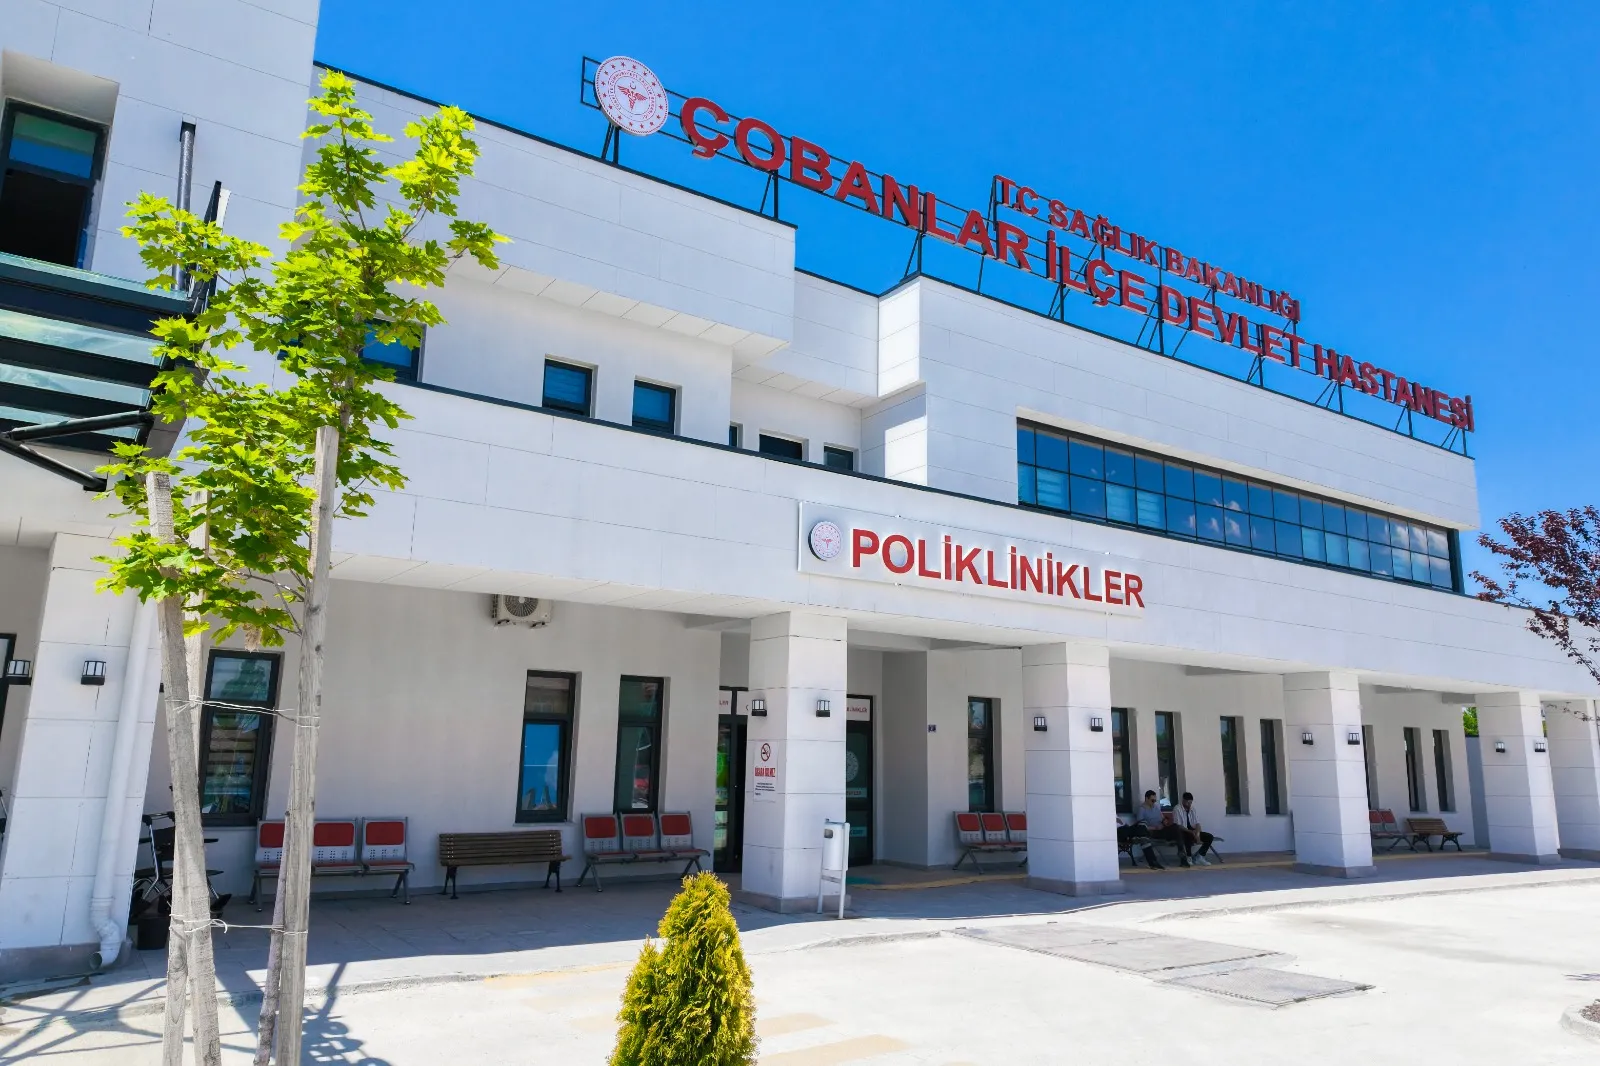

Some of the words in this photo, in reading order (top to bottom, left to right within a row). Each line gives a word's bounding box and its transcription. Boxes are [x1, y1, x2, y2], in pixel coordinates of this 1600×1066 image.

[680, 97, 1032, 272] ÇOBANLAR
[1047, 229, 1148, 315] İLÇE
[1159, 284, 1306, 369] DEVLET
[1314, 343, 1475, 433] HASTANESİ
[1048, 199, 1160, 268] SAĞLIK
[1165, 247, 1300, 321] BAKANLIĞI
[852, 528, 1145, 608] POLİKLİNİKLER
